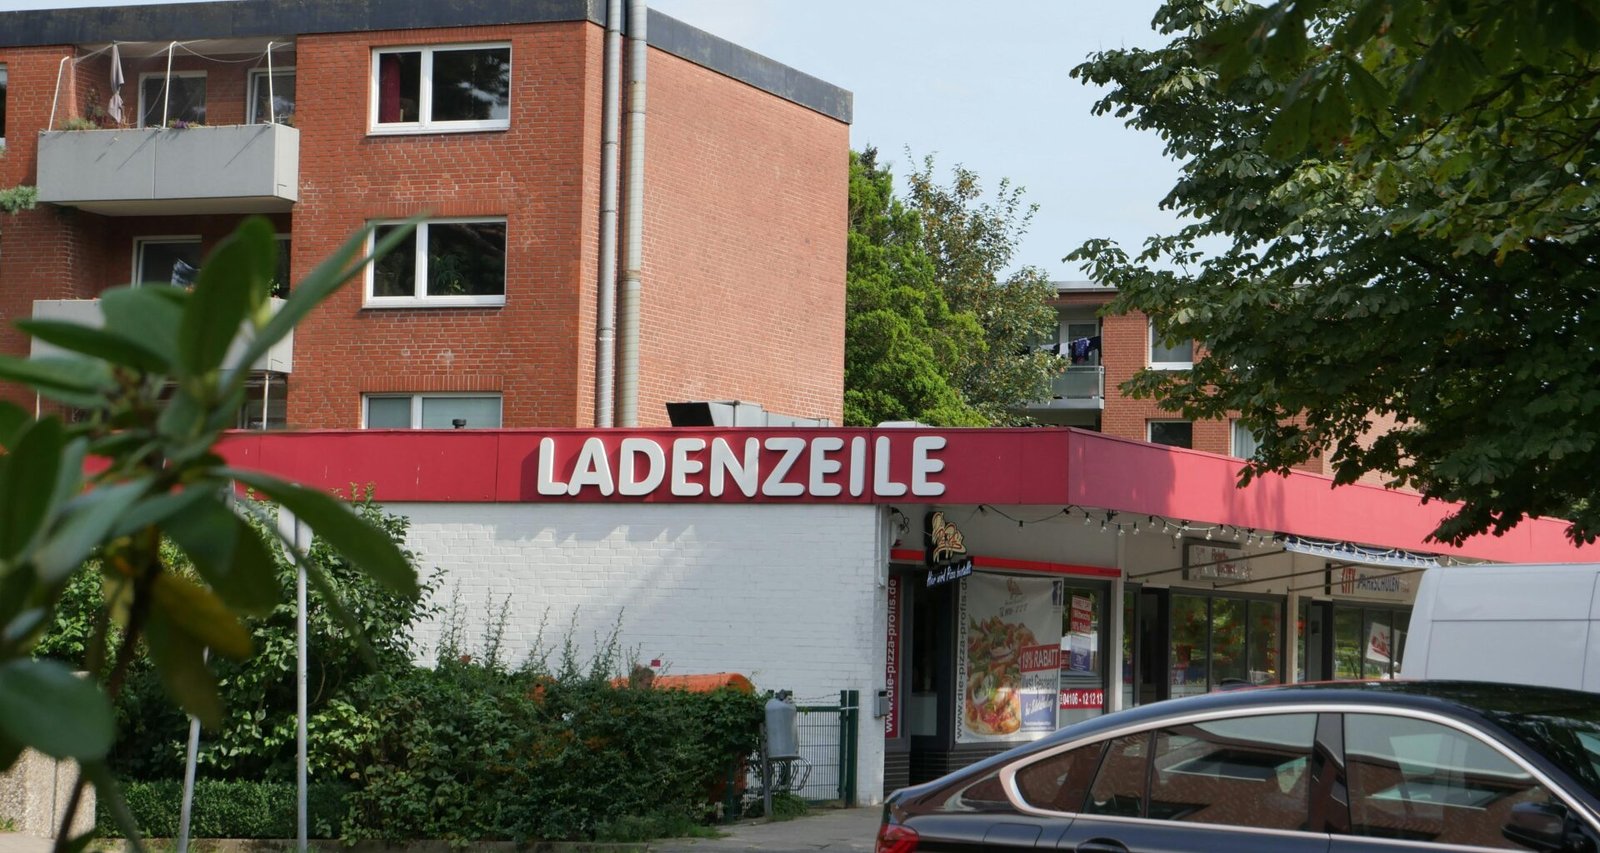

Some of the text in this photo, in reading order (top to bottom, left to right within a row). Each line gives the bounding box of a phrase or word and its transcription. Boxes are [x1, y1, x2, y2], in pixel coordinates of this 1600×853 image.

[536, 436, 948, 498] LADENZEILE
[885, 578, 898, 734] www.die-pizza-profis.de
[1033, 649, 1059, 668] RABATT
[1062, 693, 1078, 705] 04106
[1082, 693, 1089, 705] 12
[1089, 693, 1096, 705] 12
[1096, 693, 1104, 705] 13
